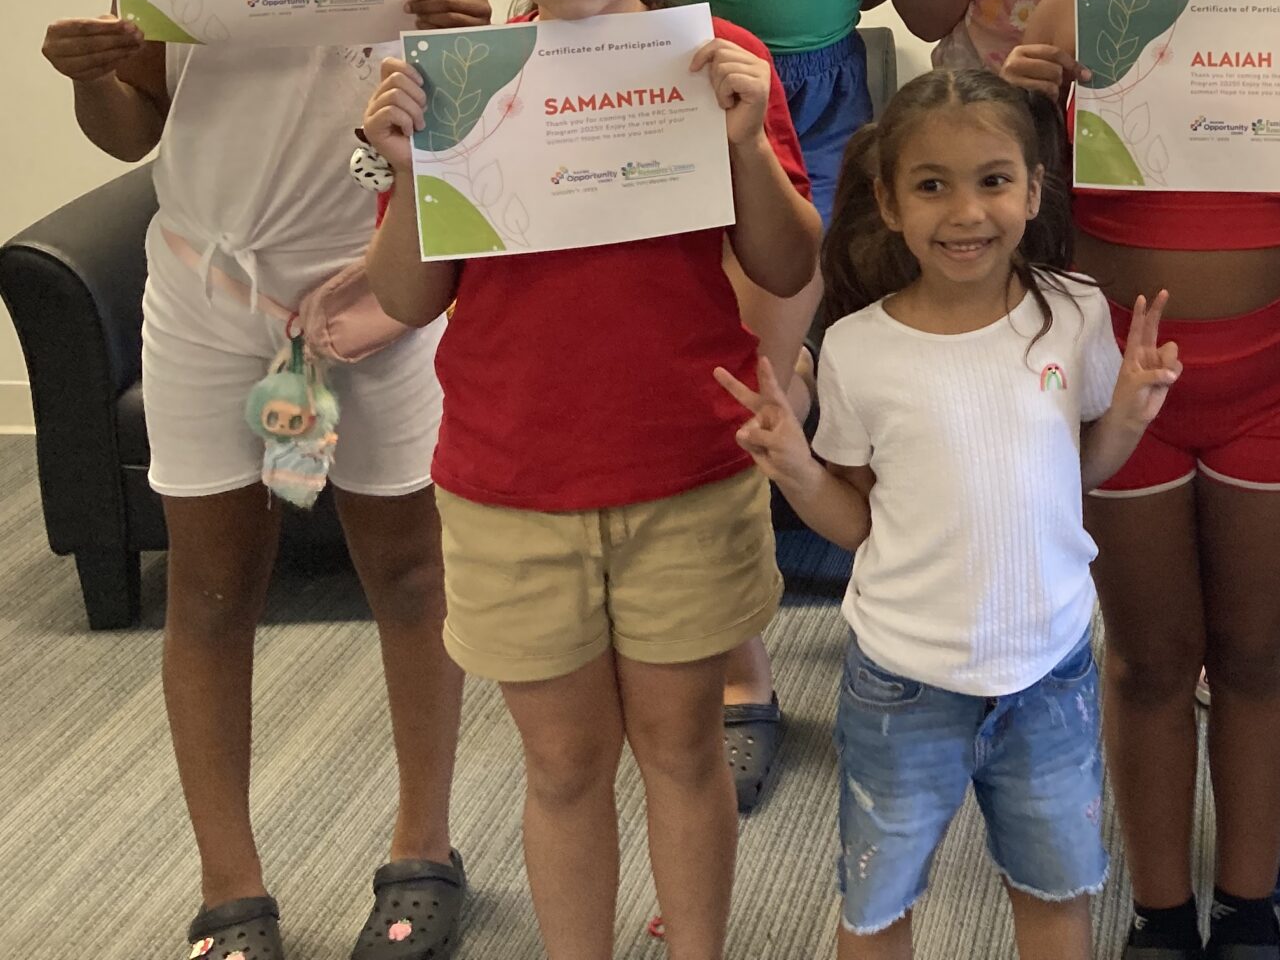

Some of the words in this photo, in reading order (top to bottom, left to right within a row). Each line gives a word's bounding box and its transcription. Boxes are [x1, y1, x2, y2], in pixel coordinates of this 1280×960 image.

[538, 46, 592, 56] Certificate
[608, 40, 671, 50] Participation
[1190, 51, 1272, 68] ALAIAH
[544, 86, 685, 115] SAMANTHA
[567, 171, 617, 182] Opportunity
